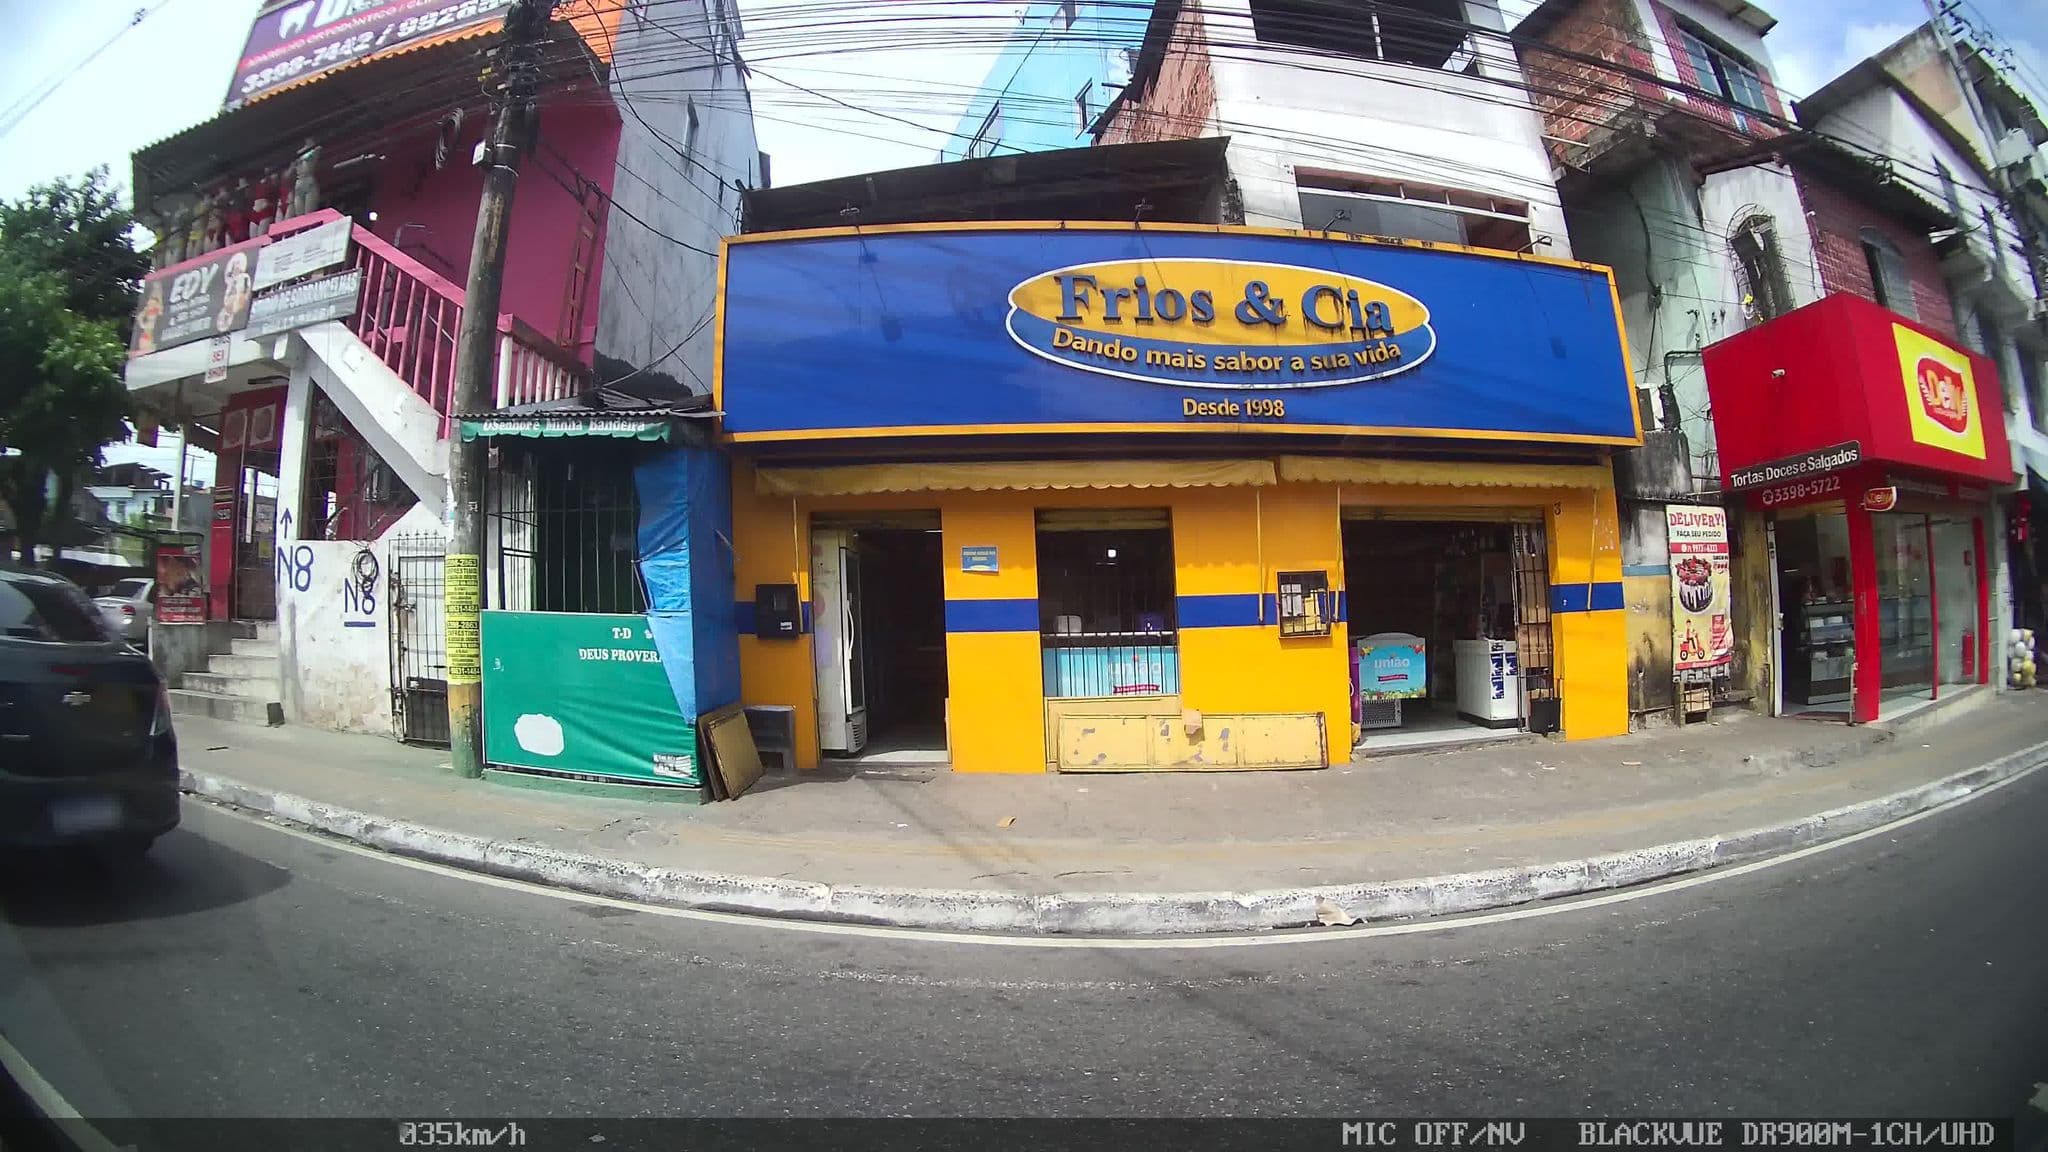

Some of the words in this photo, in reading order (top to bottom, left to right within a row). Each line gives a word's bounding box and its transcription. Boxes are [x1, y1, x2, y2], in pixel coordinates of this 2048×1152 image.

[1054, 274, 1214, 324] Frios
[1235, 281, 1287, 326] &
[1302, 284, 1395, 334] Cia
[1053, 328, 1138, 362] Dando
[1146, 348, 1206, 371] mais
[1214, 349, 1283, 372] sabor
[1291, 355, 1305, 370] a
[1311, 351, 1351, 371] sua
[1354, 342, 1402, 364] vida
[1182, 398, 1240, 416] Desde
[1244, 398, 1285, 417] 1998
[1731, 472, 1764, 487] Tortas
[1766, 463, 1799, 480] Doces
[1799, 463, 1807, 472] e
[1807, 449, 1858, 471] Salgados
[1774, 476, 1841, 502] 3398-5722
[1669, 512, 1724, 527] DELIVERY!
[277, 545, 314, 593] N8
[578, 648, 609, 661] DEUS
